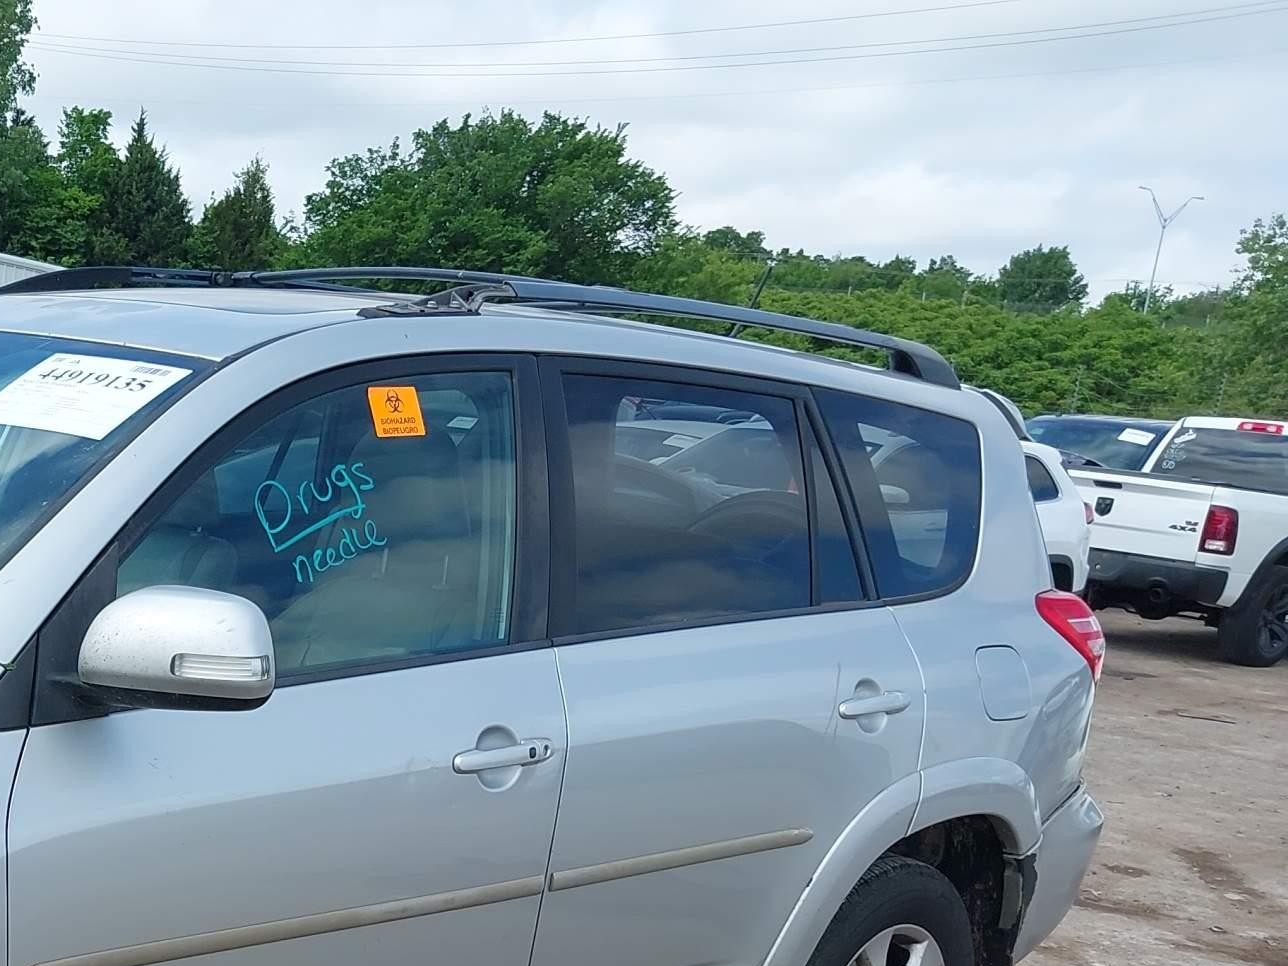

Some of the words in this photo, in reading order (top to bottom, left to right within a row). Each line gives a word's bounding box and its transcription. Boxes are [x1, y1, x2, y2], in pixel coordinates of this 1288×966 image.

[38, 367, 154, 392] 44919135
[380, 416, 416, 425] BIOHAZARD
[255, 462, 375, 552] Drugs
[292, 519, 387, 583] needle
